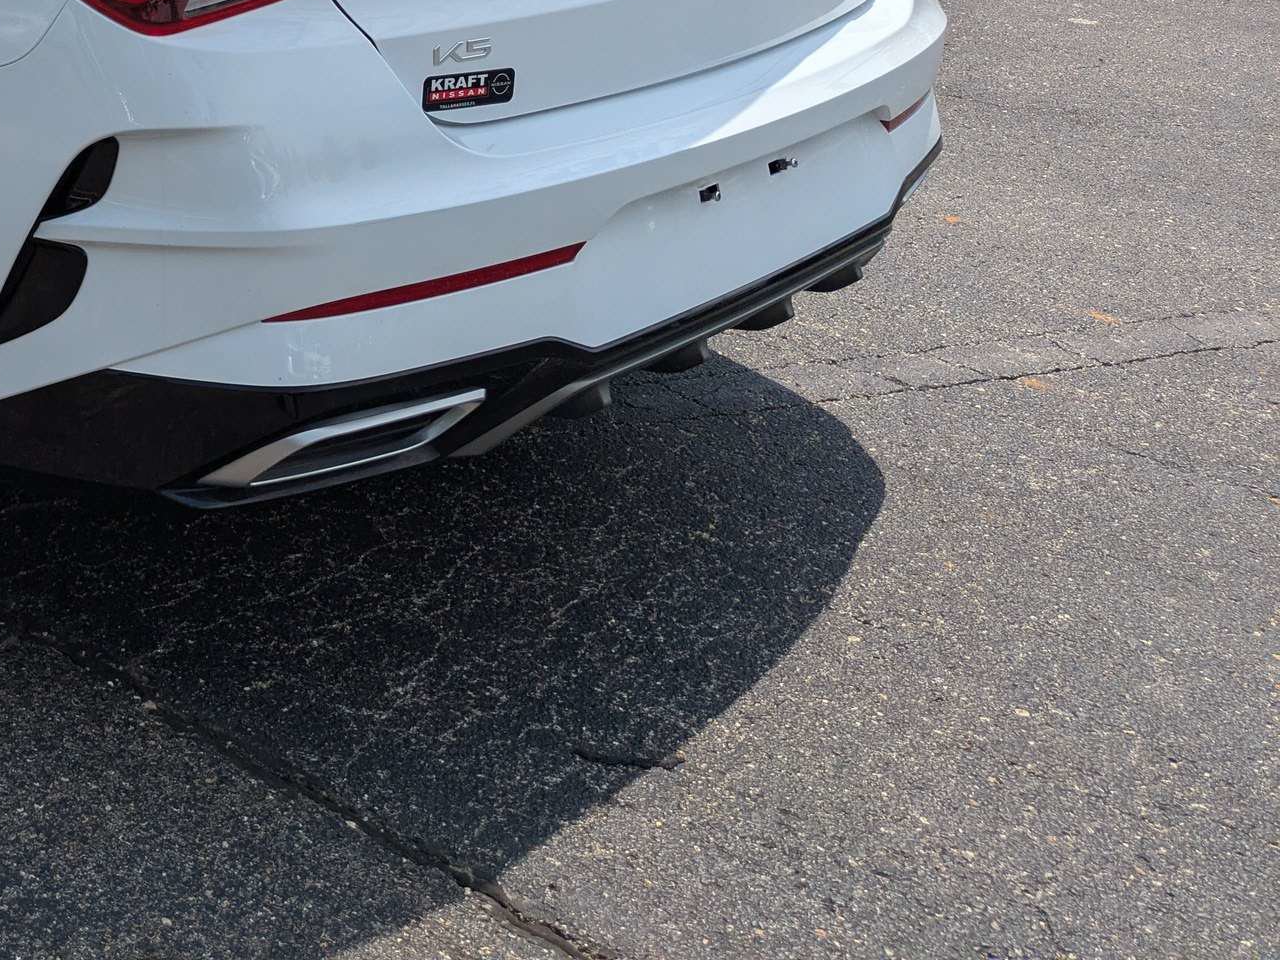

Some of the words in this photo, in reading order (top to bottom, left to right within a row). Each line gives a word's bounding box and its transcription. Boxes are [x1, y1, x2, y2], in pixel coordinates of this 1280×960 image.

[432, 37, 492, 67] K5
[431, 74, 489, 92] KRAFT
[432, 88, 486, 100] NISSAN
